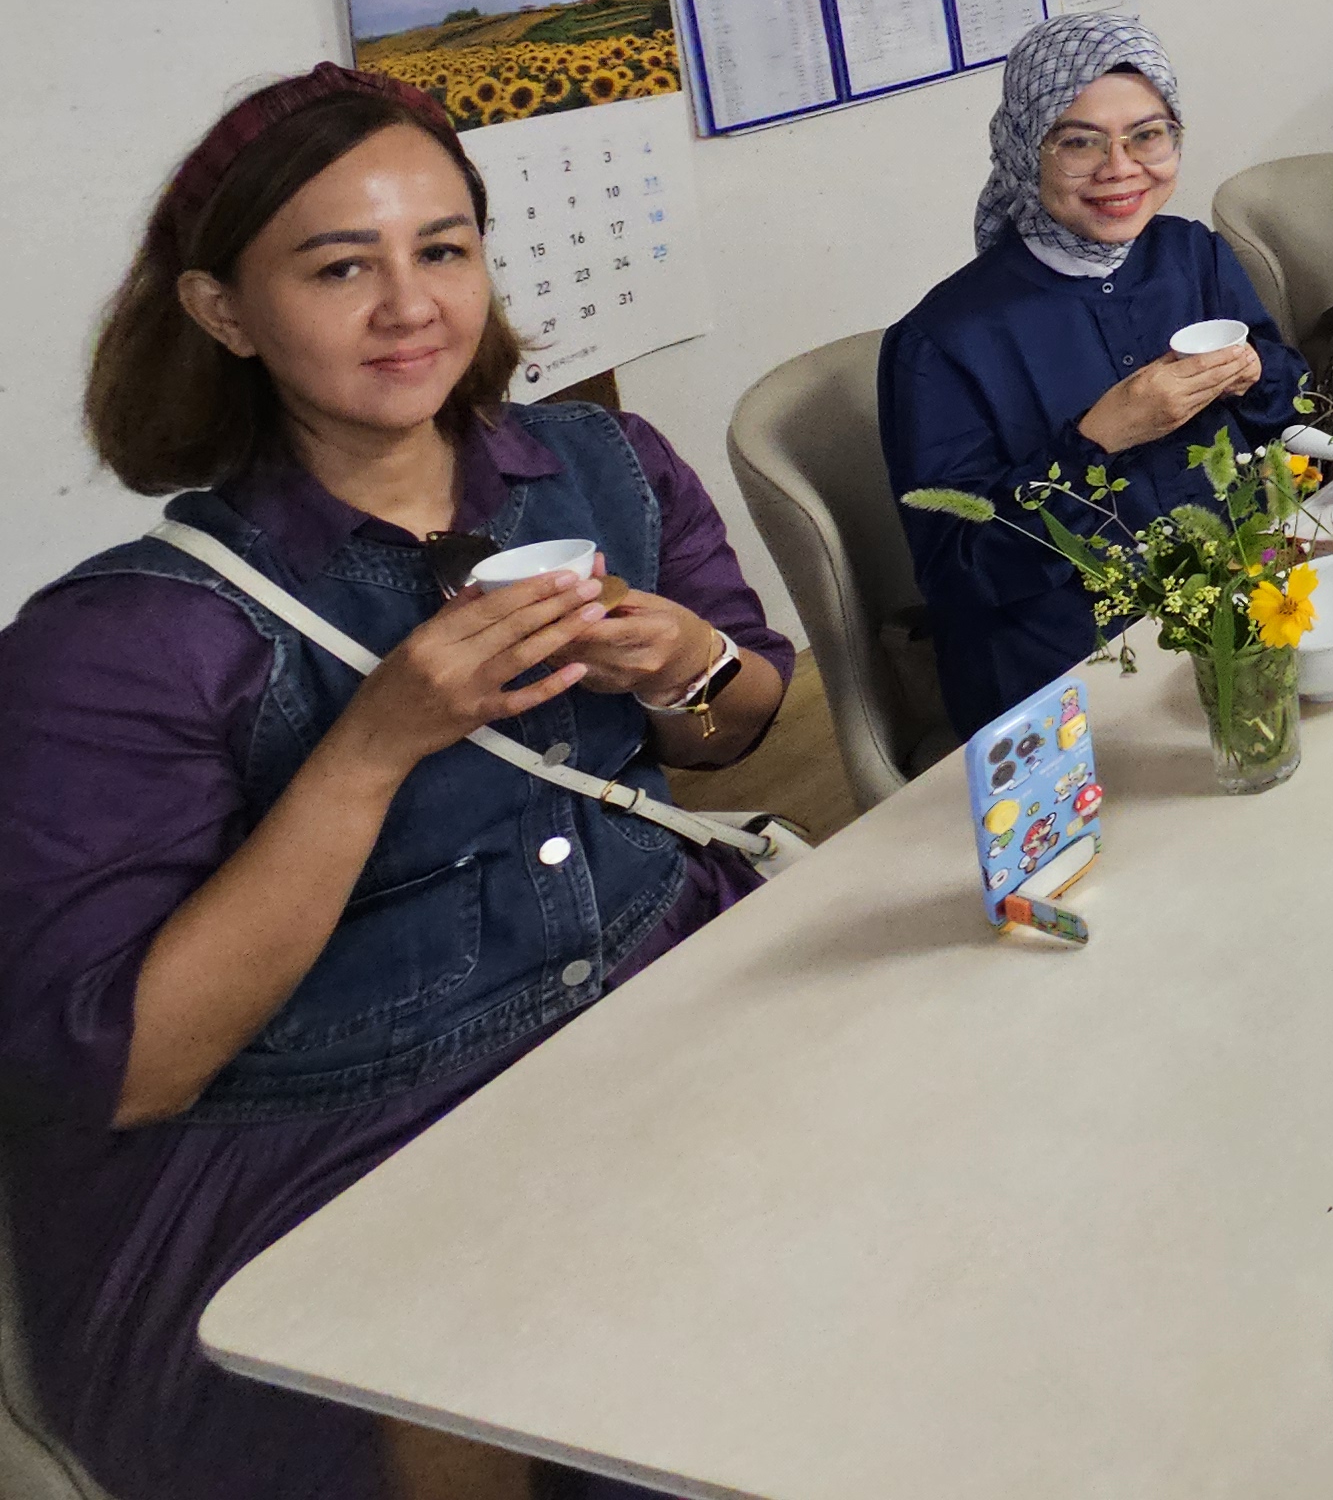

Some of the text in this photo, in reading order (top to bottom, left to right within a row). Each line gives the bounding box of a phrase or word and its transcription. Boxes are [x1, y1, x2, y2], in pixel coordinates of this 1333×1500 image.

[521, 168, 529, 182] 1
[563, 159, 572, 172] 2
[603, 151, 612, 163] 3
[527, 206, 536, 219] 8
[568, 196, 576, 209] 9
[606, 185, 620, 199] 10
[493, 255, 507, 271] 14
[530, 242, 546, 258] 15
[570, 231, 585, 246] 16
[610, 220, 624, 234] 17
[536, 280, 551, 297] 22
[575, 267, 591, 283] 23
[613, 255, 630, 270] 24
[652, 243, 667, 259] 25
[541, 290, 633, 334] 29 30 31
